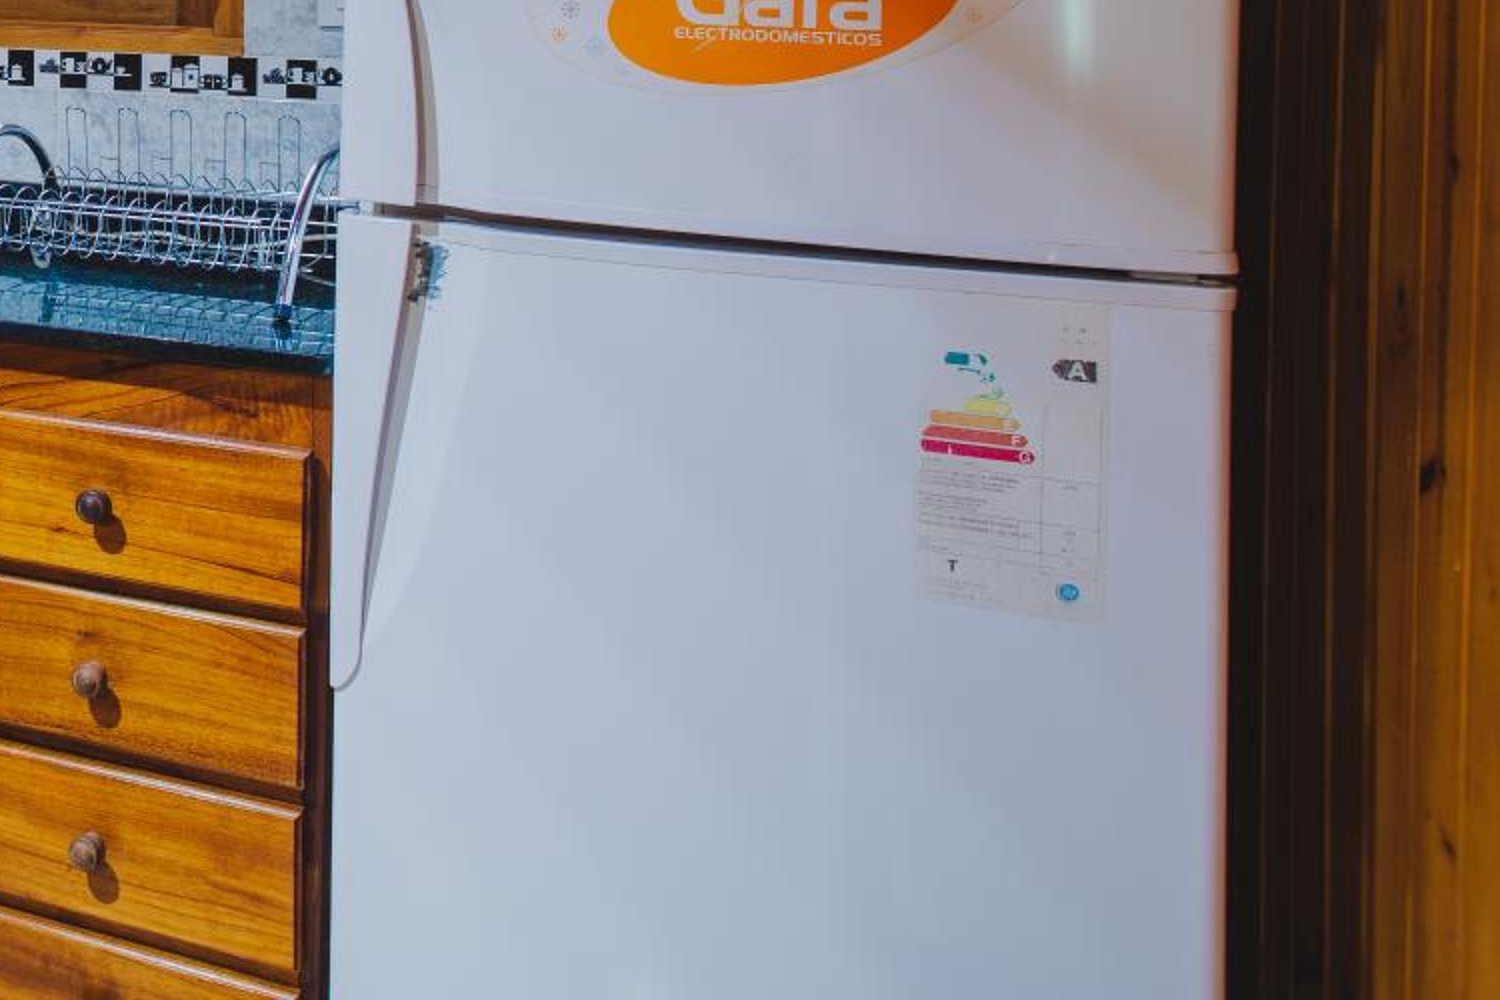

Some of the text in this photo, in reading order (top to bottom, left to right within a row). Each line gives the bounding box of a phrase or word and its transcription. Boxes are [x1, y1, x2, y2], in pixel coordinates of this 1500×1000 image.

[674, 27, 883, 47] ELECTRODOMESTICOS
[1068, 361, 1087, 380] A
[947, 560, 959, 572] T
